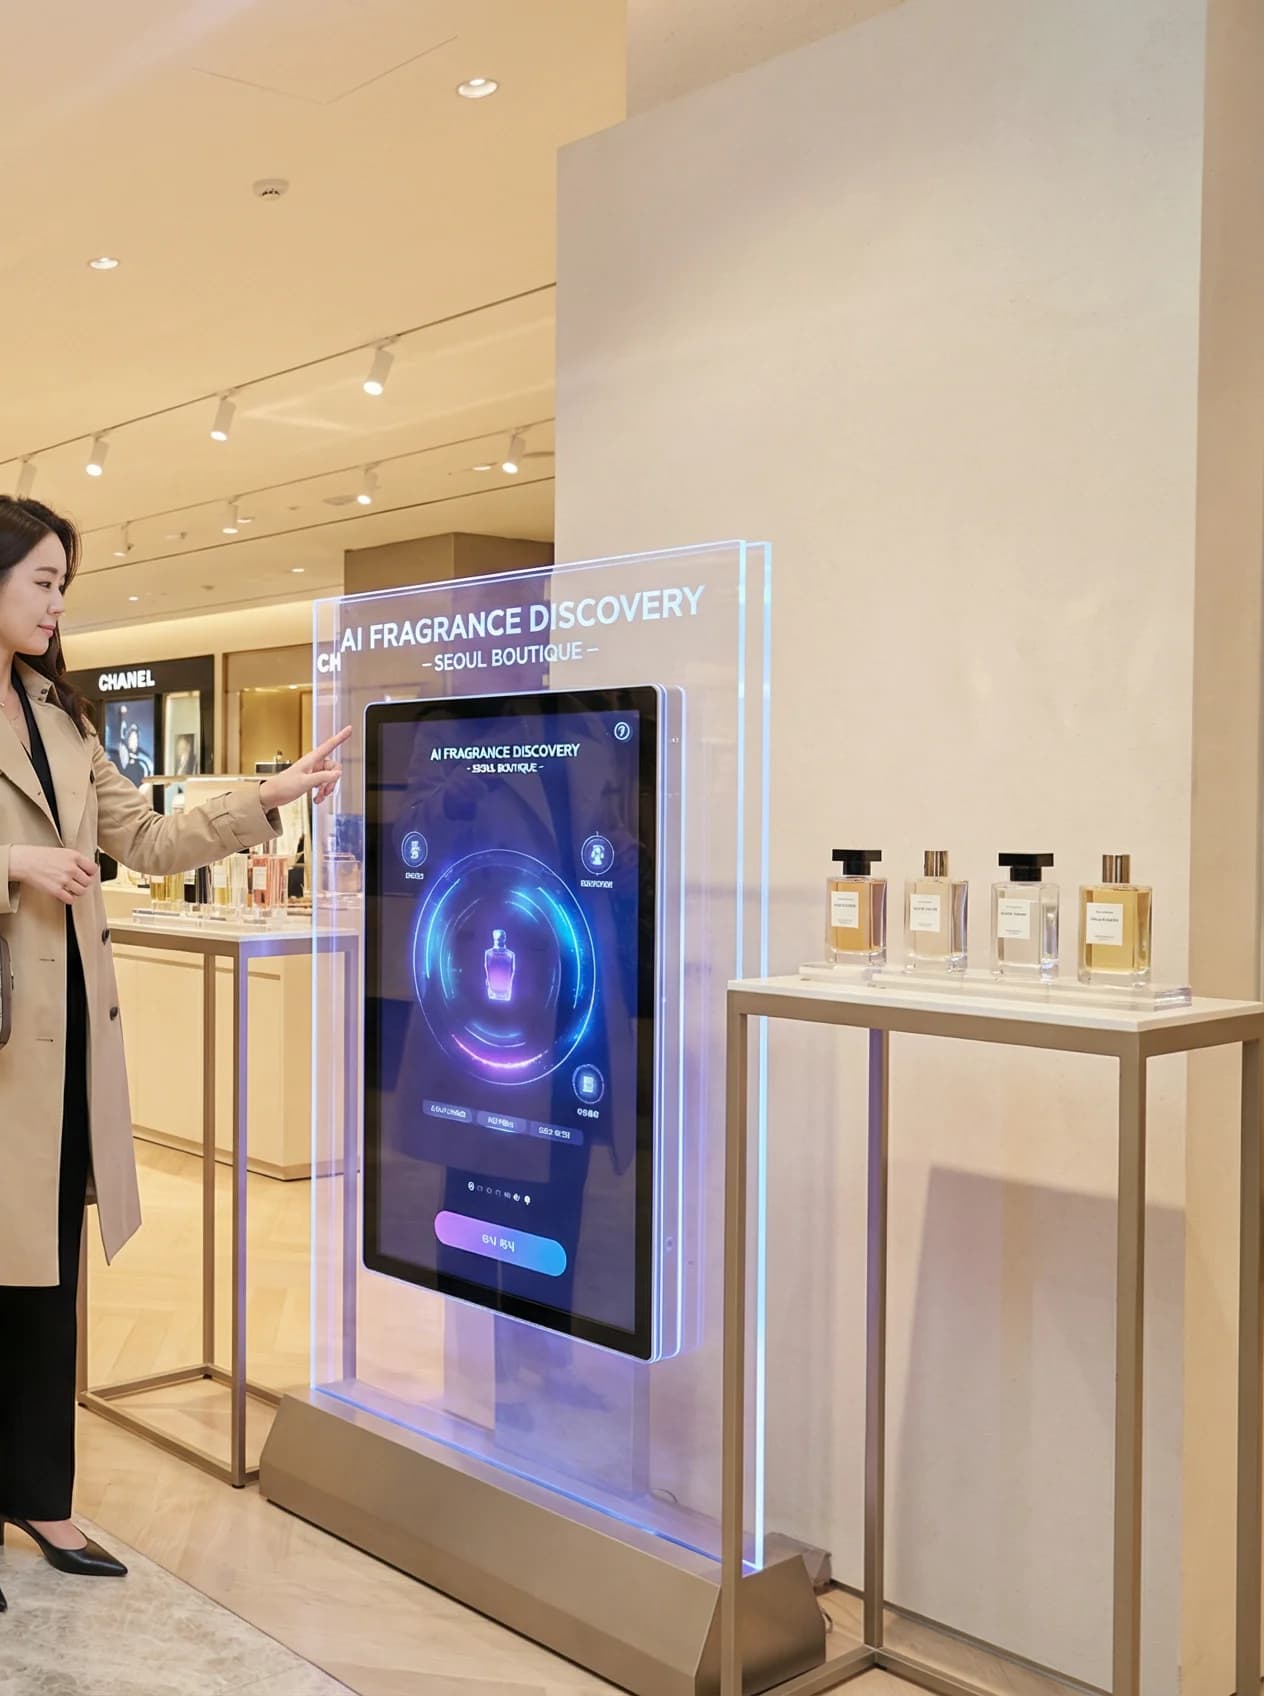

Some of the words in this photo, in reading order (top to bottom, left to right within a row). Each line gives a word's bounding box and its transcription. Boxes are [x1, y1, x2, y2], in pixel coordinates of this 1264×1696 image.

[341, 627, 362, 653] AI
[369, 606, 522, 650] FRAGRANCE
[529, 585, 705, 634] DISCOVERY
[491, 641, 584, 667] BOUTIQUE
[98, 670, 155, 692] CHANEL
[430, 748, 442, 761] AI
[443, 745, 510, 760] FRAGRANCE
[513, 743, 580, 759] DISCOVERY
